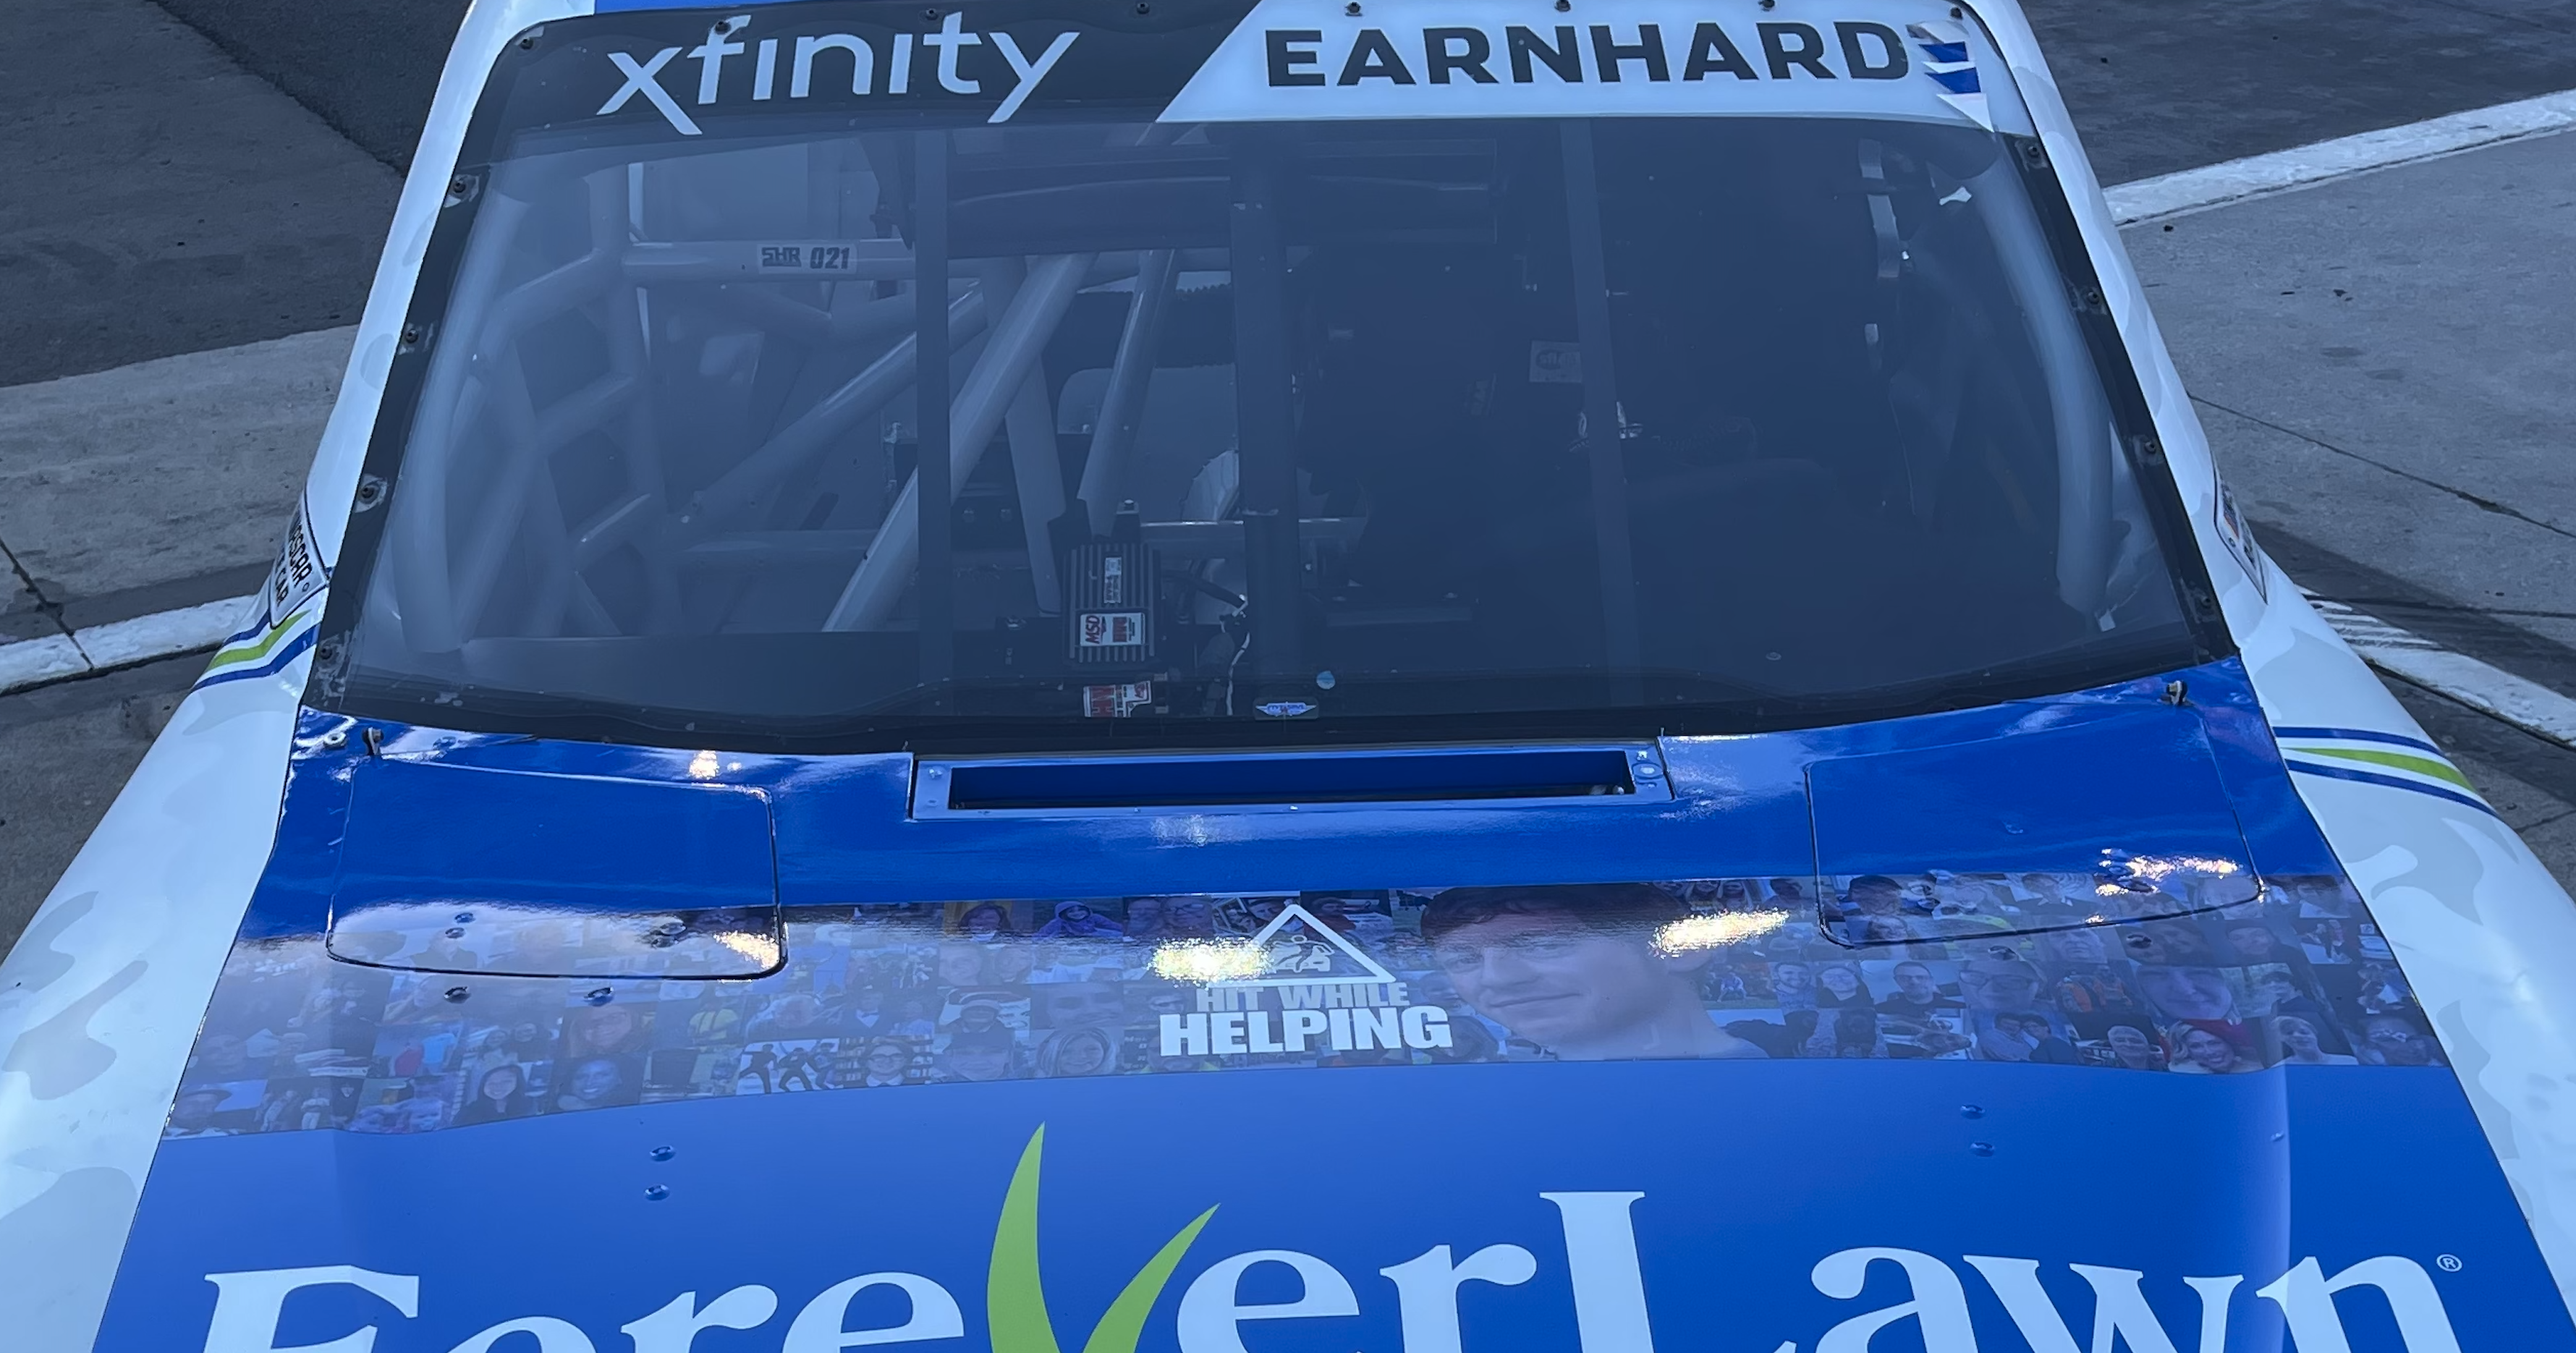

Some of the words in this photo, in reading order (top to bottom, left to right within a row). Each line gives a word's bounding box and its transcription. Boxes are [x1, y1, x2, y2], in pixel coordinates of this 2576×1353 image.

[596, 11, 1080, 135] xfinity
[1264, 20, 1944, 88] EARNHARD
[761, 247, 802, 267] SHR
[810, 247, 850, 269] 021
[1085, 615, 1101, 644] MSD
[1196, 987, 1263, 1012] HIT
[1278, 982, 1410, 1010] WHILE
[1160, 1006, 1453, 1057] HELPING
[204, 1121, 2462, 1353] FreverLawn
